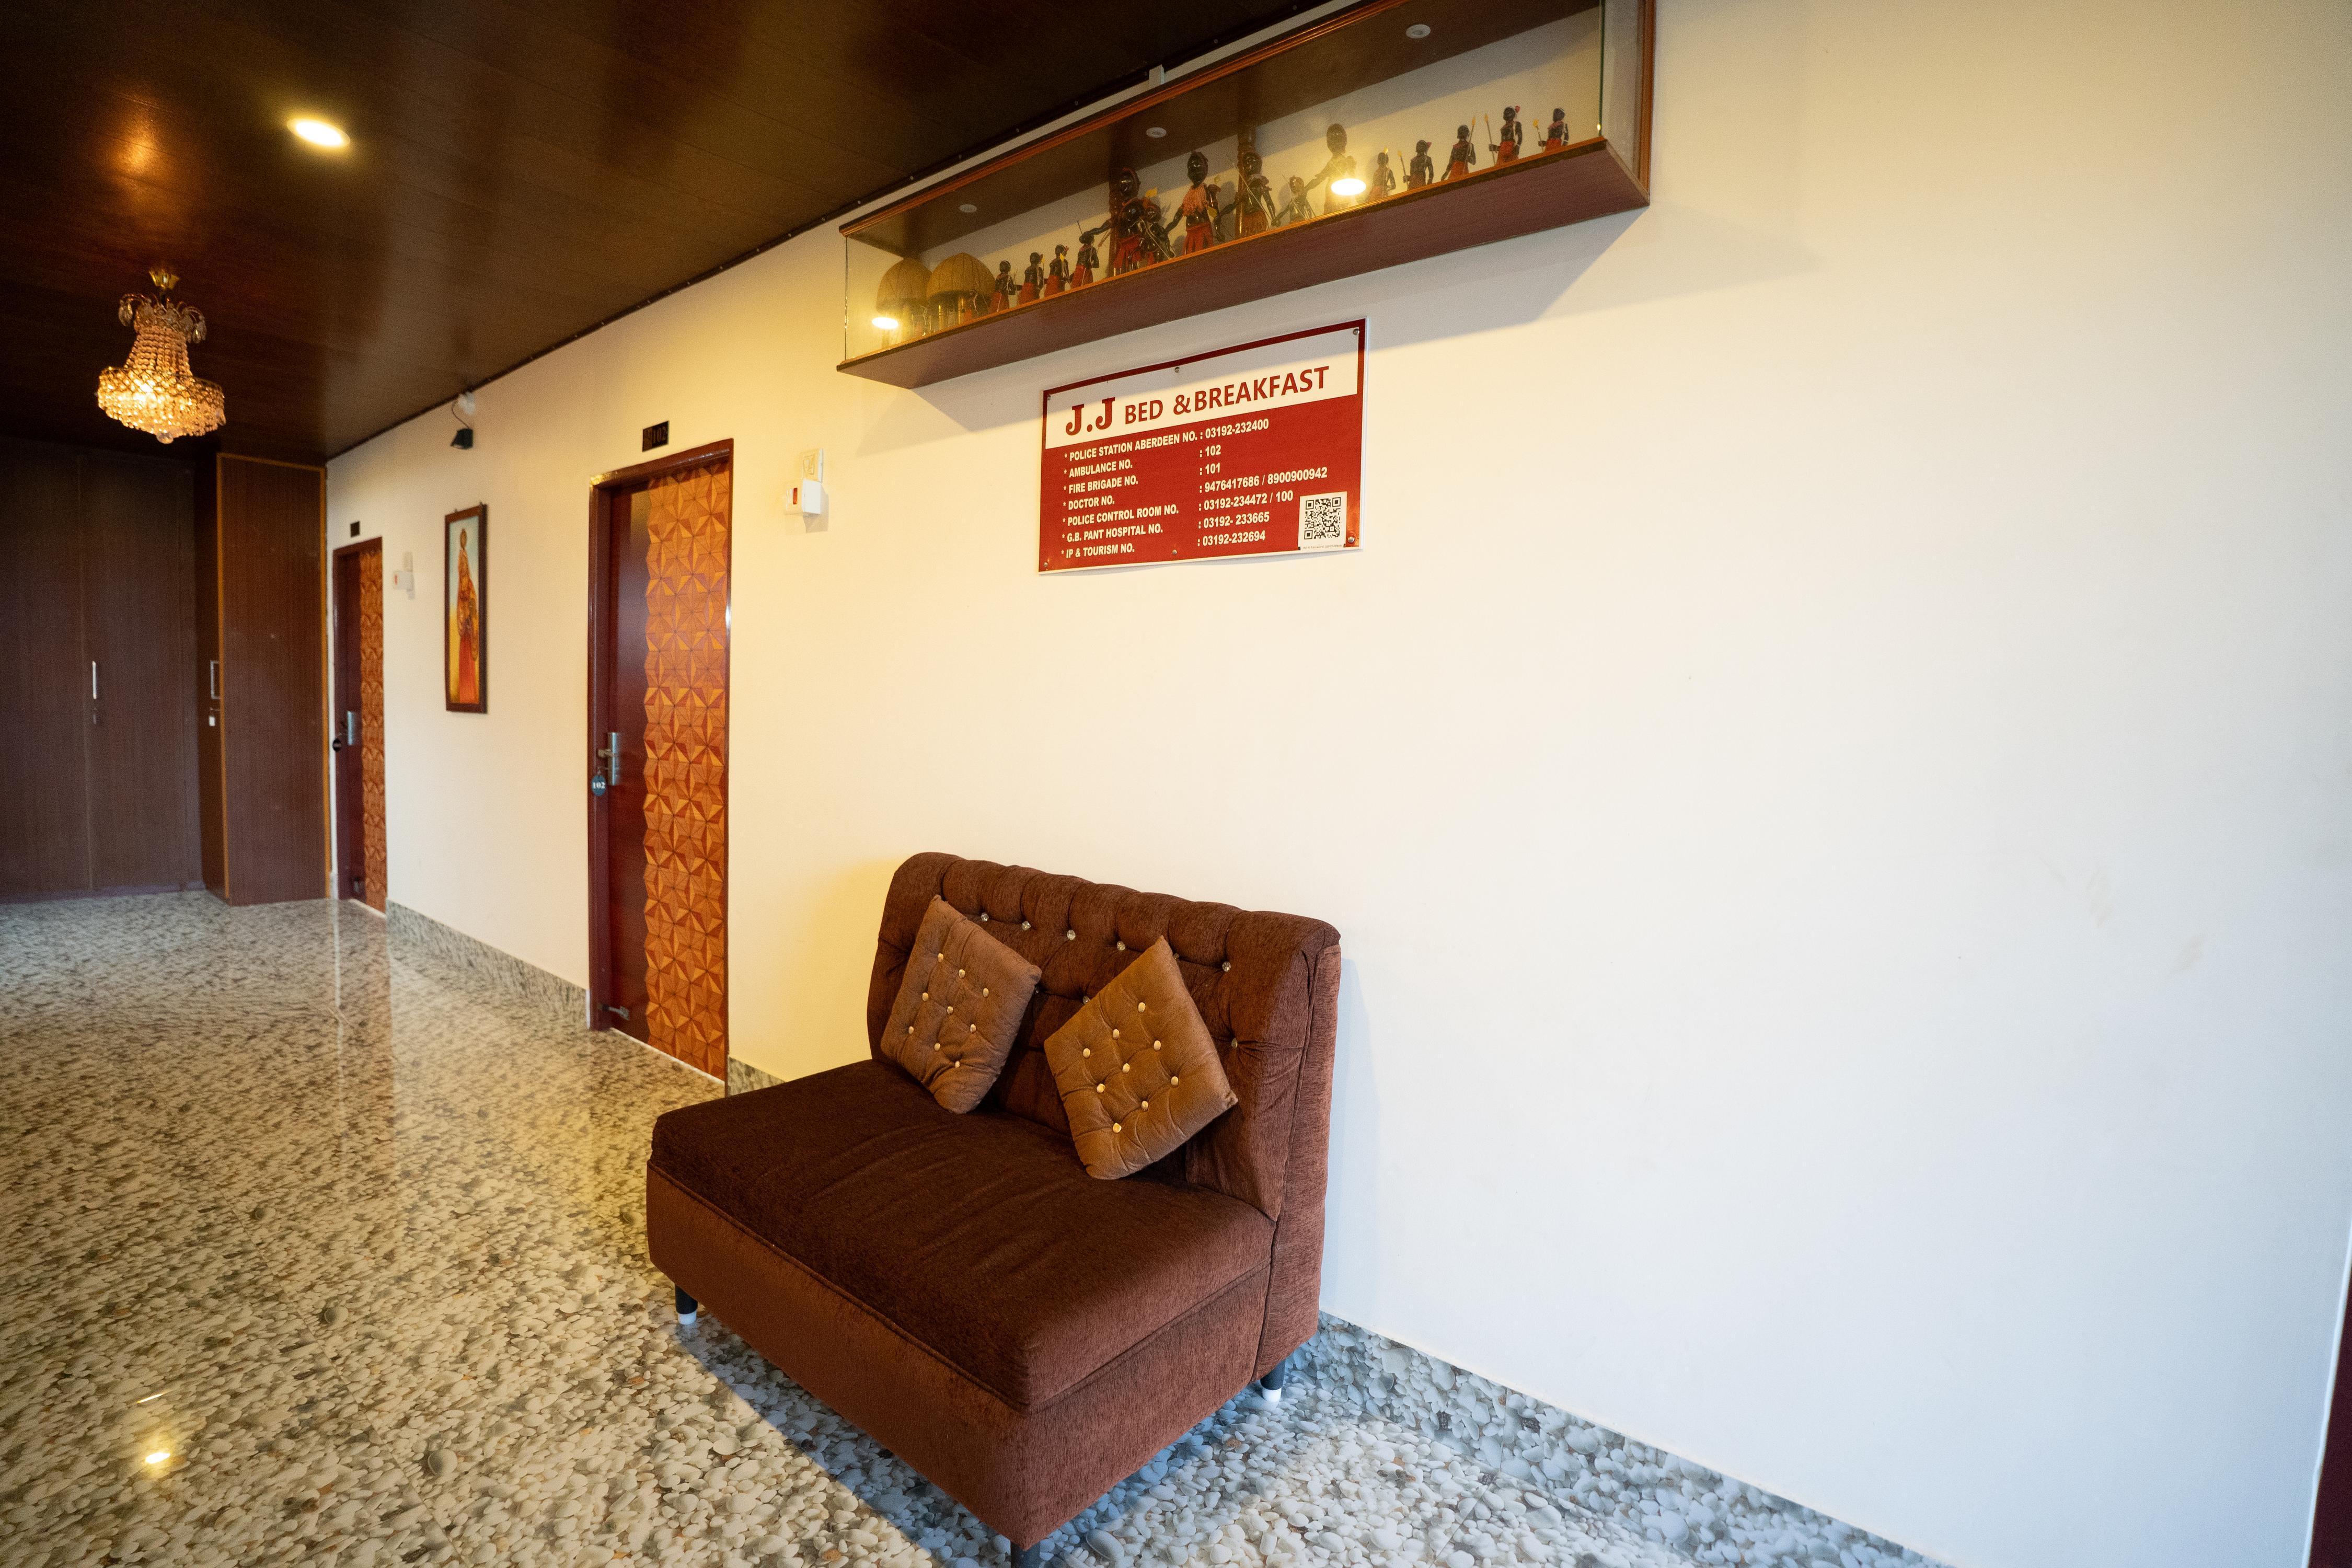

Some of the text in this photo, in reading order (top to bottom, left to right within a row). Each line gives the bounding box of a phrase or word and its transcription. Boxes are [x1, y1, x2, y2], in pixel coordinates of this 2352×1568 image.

[1066, 397, 1115, 436] J.J
[1125, 399, 1163, 424] BED
[1069, 447, 1097, 461] POLICE
[1099, 442, 1133, 456] STATION
[1135, 434, 1180, 450] ABERDEEN
[1183, 430, 1197, 443] NO.
[1069, 461, 1116, 478] AMBULANCE
[1119, 459, 1133, 469] NO.
[1205, 444, 1221, 457] 102
[1068, 483, 1086, 493] FIRE
[1088, 477, 1122, 490] BRIGADE
[1124, 475, 1138, 485] NO.
[1205, 463, 1220, 474] 101
[1068, 498, 1099, 510] DOCTOR
[1101, 495, 1114, 505] NO.
[1205, 476, 1259, 492] 9476417686
[1267, 467, 1328, 485] 8900900942
[1067, 515, 1094, 526] POLICE
[1097, 509, 1134, 523] CONTROL
[1137, 506, 1161, 518] ROOM
[1164, 504, 1179, 515] NO.
[1276, 490, 1293, 501] 100
[1067, 533, 1081, 542] G.B.
[1083, 529, 1104, 540] PANT
[1106, 525, 1146, 538] HOSPITAL
[1148, 524, 1163, 534] NO.
[1066, 549, 1073, 558] IP
[1075, 548, 1080, 557] &
[1083, 544, 1119, 556] TOURISM
[1121, 543, 1134, 553] NO.
